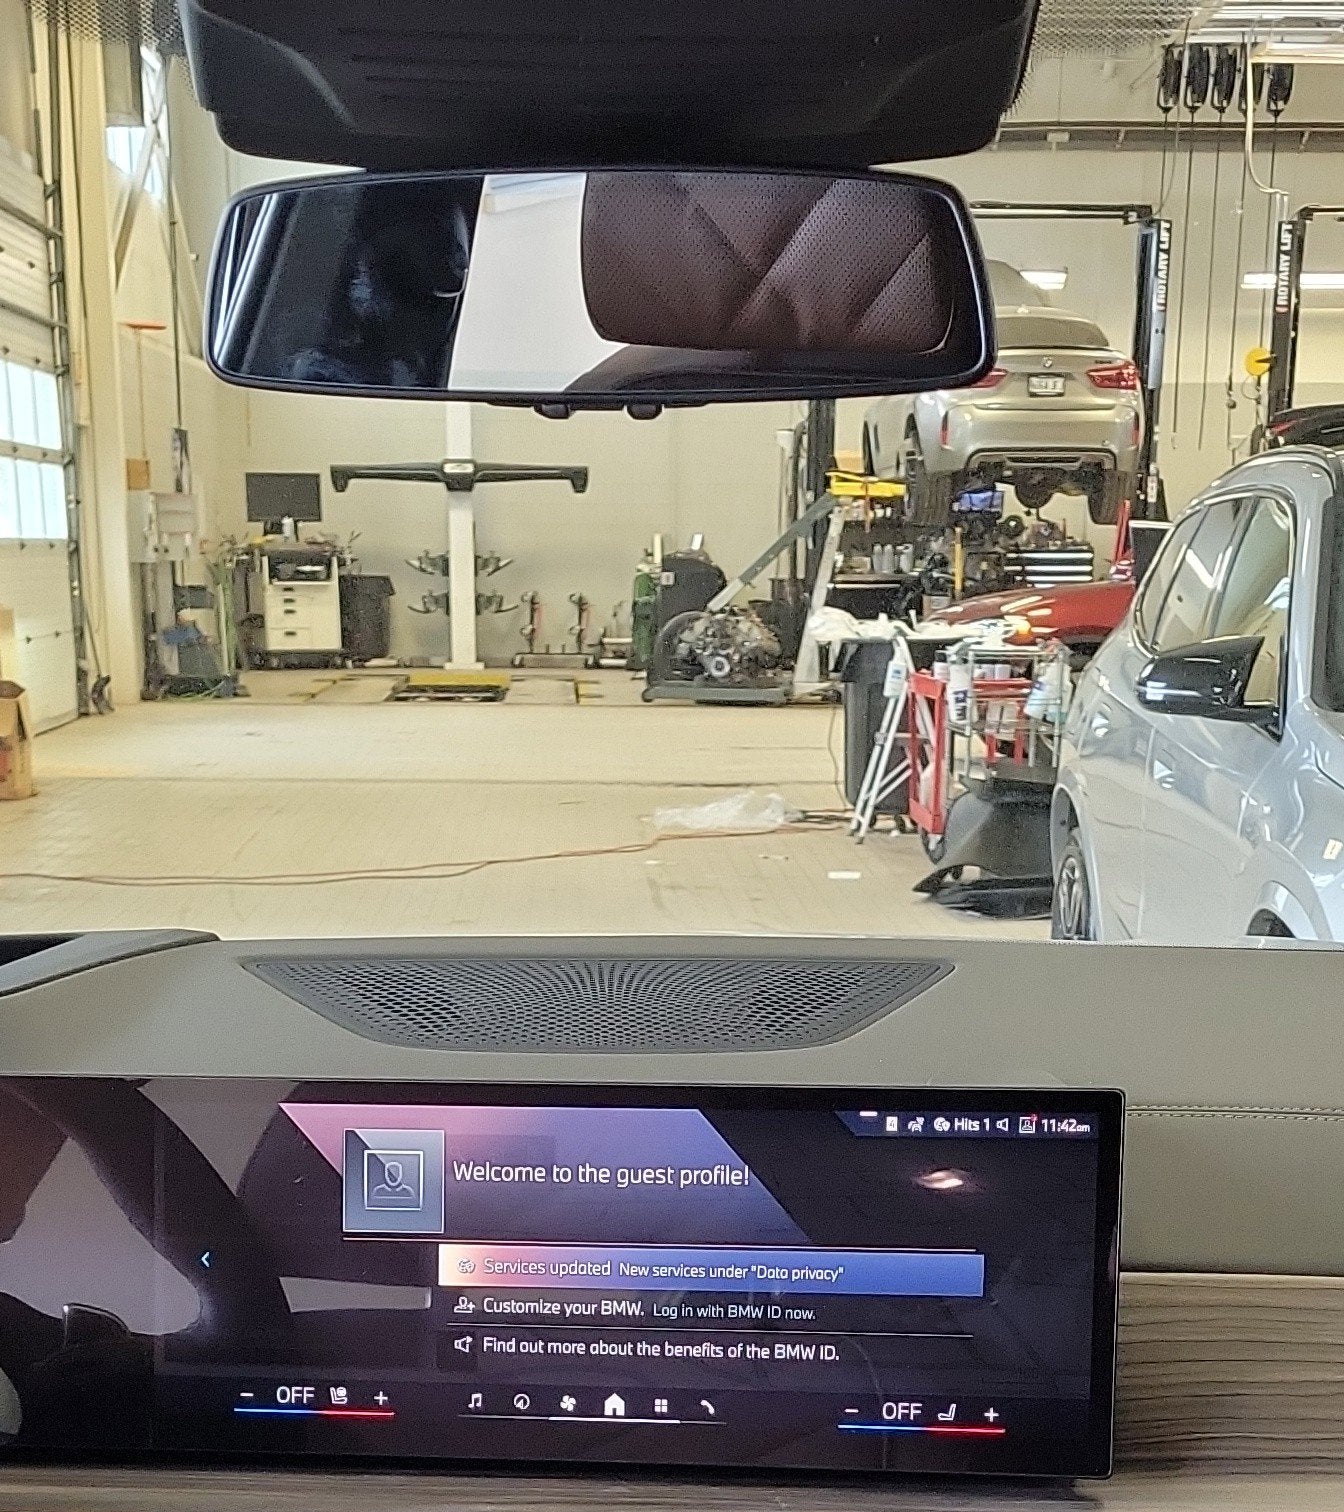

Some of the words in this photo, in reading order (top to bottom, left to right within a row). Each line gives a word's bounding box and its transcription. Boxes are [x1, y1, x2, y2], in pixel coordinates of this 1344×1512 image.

[1280, 223, 1293, 251] LIFT
[1277, 253, 1291, 305] ROTARY
[954, 1118, 980, 1132] Hits
[984, 1118, 990, 1131] 1
[1042, 1118, 1091, 1133] 11:42am
[453, 1161, 546, 1182] Welcome
[552, 1166, 572, 1183] to
[578, 1163, 610, 1183] the
[617, 1166, 674, 1188] guest
[680, 1165, 750, 1188] profile!
[483, 1258, 546, 1275] Services
[550, 1260, 611, 1277] updated
[619, 1263, 649, 1277] New
[652, 1264, 706, 1278] services
[709, 1265, 749, 1279] under
[751, 1265, 789, 1280] "Data
[791, 1266, 844, 1282] privacy"
[483, 1297, 561, 1314] Customize
[564, 1303, 598, 1317] your
[601, 1300, 645, 1316] BMW.
[653, 1303, 678, 1319] Log
[681, 1304, 693, 1317] in
[697, 1304, 724, 1318] with
[727, 1305, 764, 1319] BMW
[767, 1306, 782, 1319] ID
[785, 1308, 816, 1320] now.
[483, 1336, 516, 1353] Find
[520, 1339, 545, 1353] out
[548, 1341, 586, 1355] more
[589, 1340, 633, 1356] about
[636, 1341, 661, 1356] the
[664, 1341, 723, 1358] benefits
[727, 1343, 743, 1358] of
[746, 1343, 770, 1359] the
[774, 1344, 816, 1360] BMW
[819, 1345, 840, 1360] ID.
[276, 1386, 315, 1404] OFF
[882, 1402, 923, 1420] OFF
